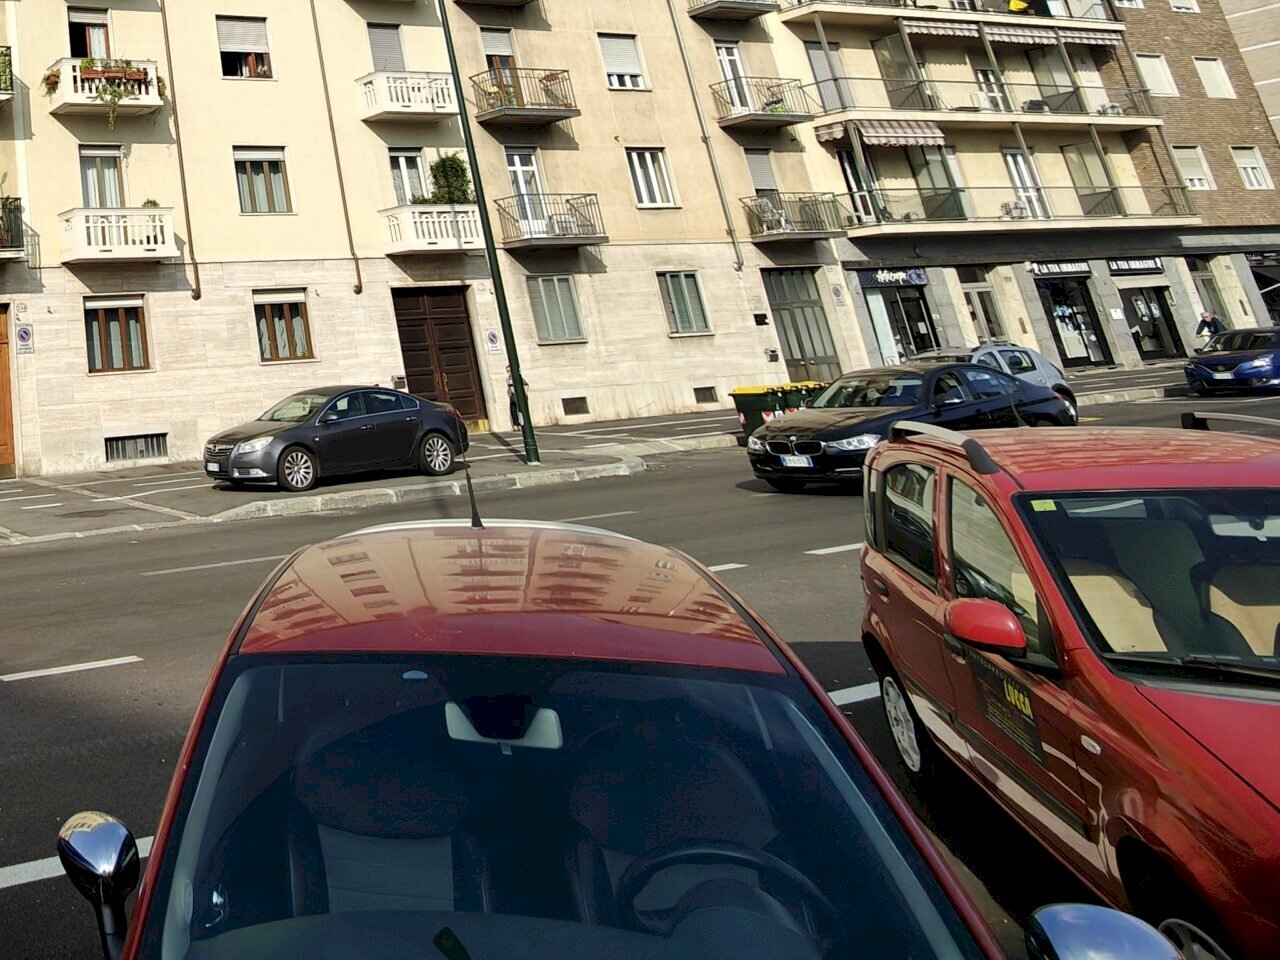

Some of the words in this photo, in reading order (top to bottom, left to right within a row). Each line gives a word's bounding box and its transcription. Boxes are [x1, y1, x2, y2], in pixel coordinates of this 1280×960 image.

[1040, 264, 1049, 273] LA
[1047, 263, 1060, 272] TUA
[1060, 262, 1089, 272] IMMAGINE
[1109, 261, 1118, 270] LA
[1117, 260, 1129, 270] TUA
[1128, 259, 1156, 269] IMMAGINE
[1003, 679, 1034, 720] LUCCA
